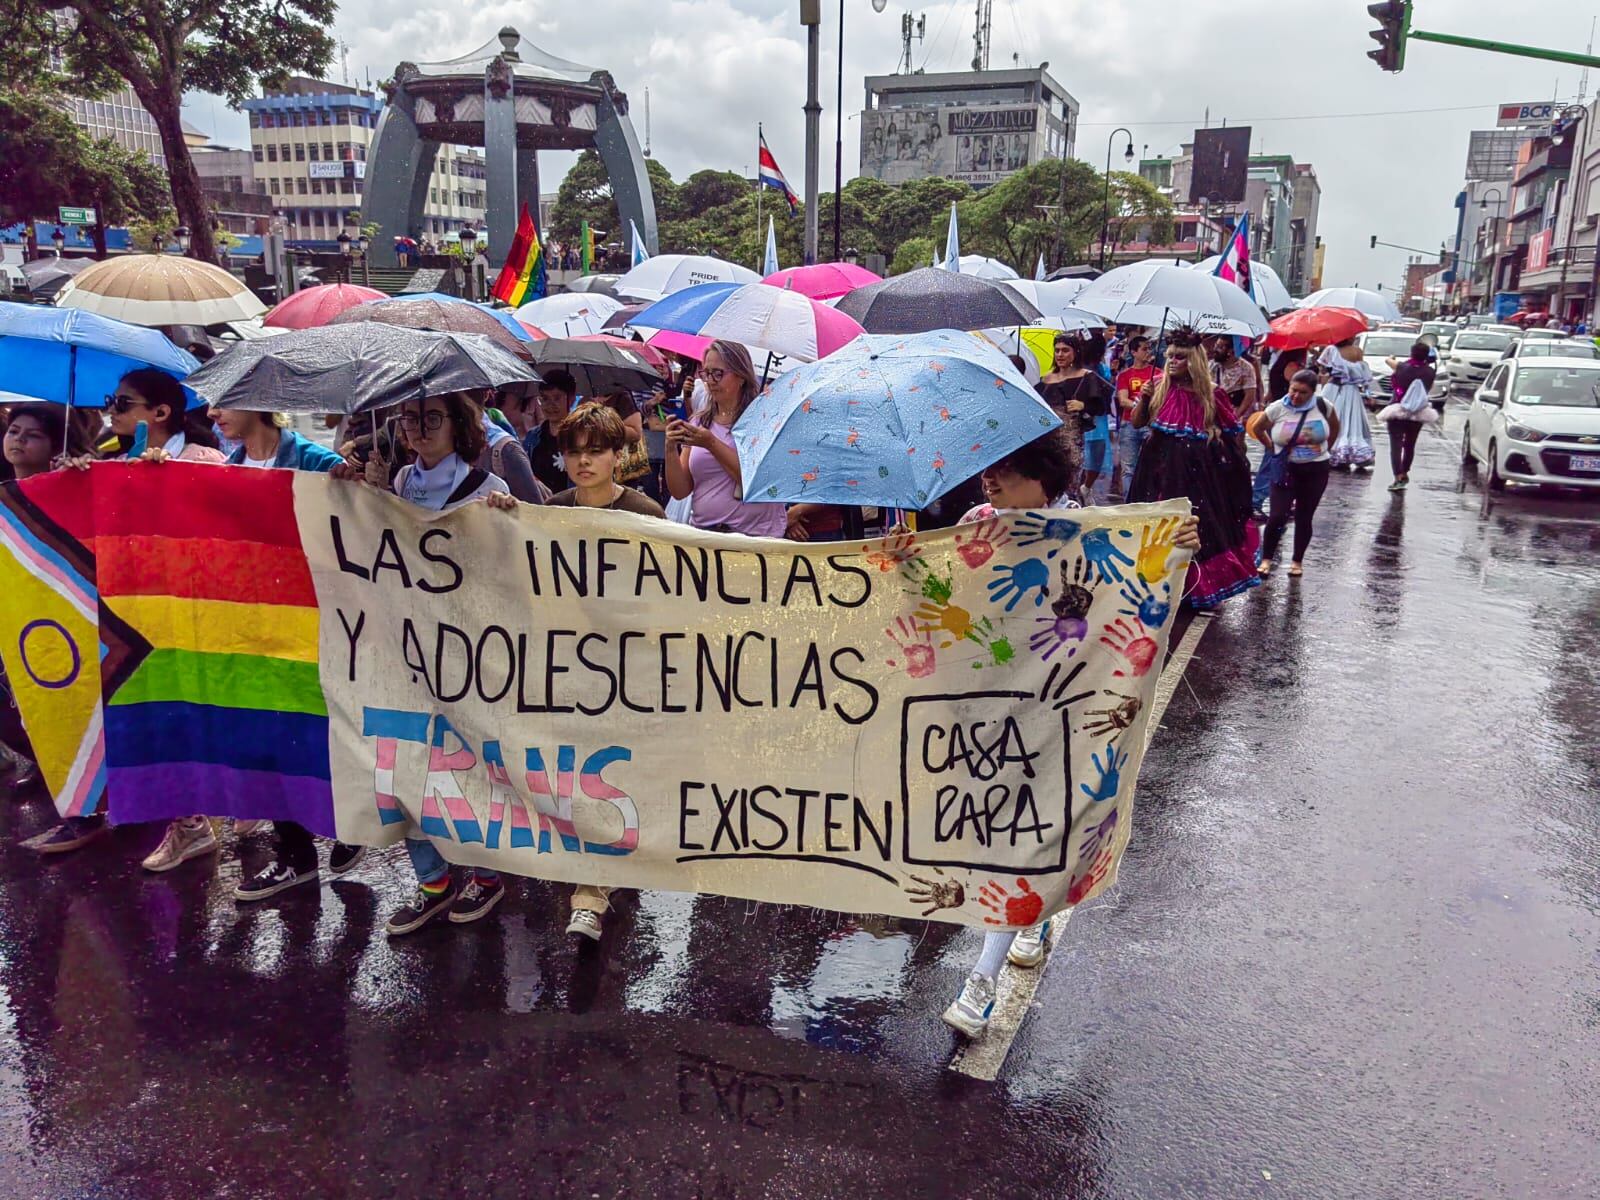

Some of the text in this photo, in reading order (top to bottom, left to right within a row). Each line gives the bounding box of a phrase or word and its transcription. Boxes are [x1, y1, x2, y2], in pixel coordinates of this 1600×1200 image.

[1519, 105, 1551, 118] BCR
[691, 271, 719, 281] PRIDE
[330, 515, 872, 608] LAS INFANCIAS
[336, 608, 880, 724] Y ADOLESCENCIAS
[362, 706, 639, 856] TRANS
[922, 716, 1040, 781] CASA
[679, 781, 892, 861] EXISTEN
[934, 784, 1053, 847] PARA
